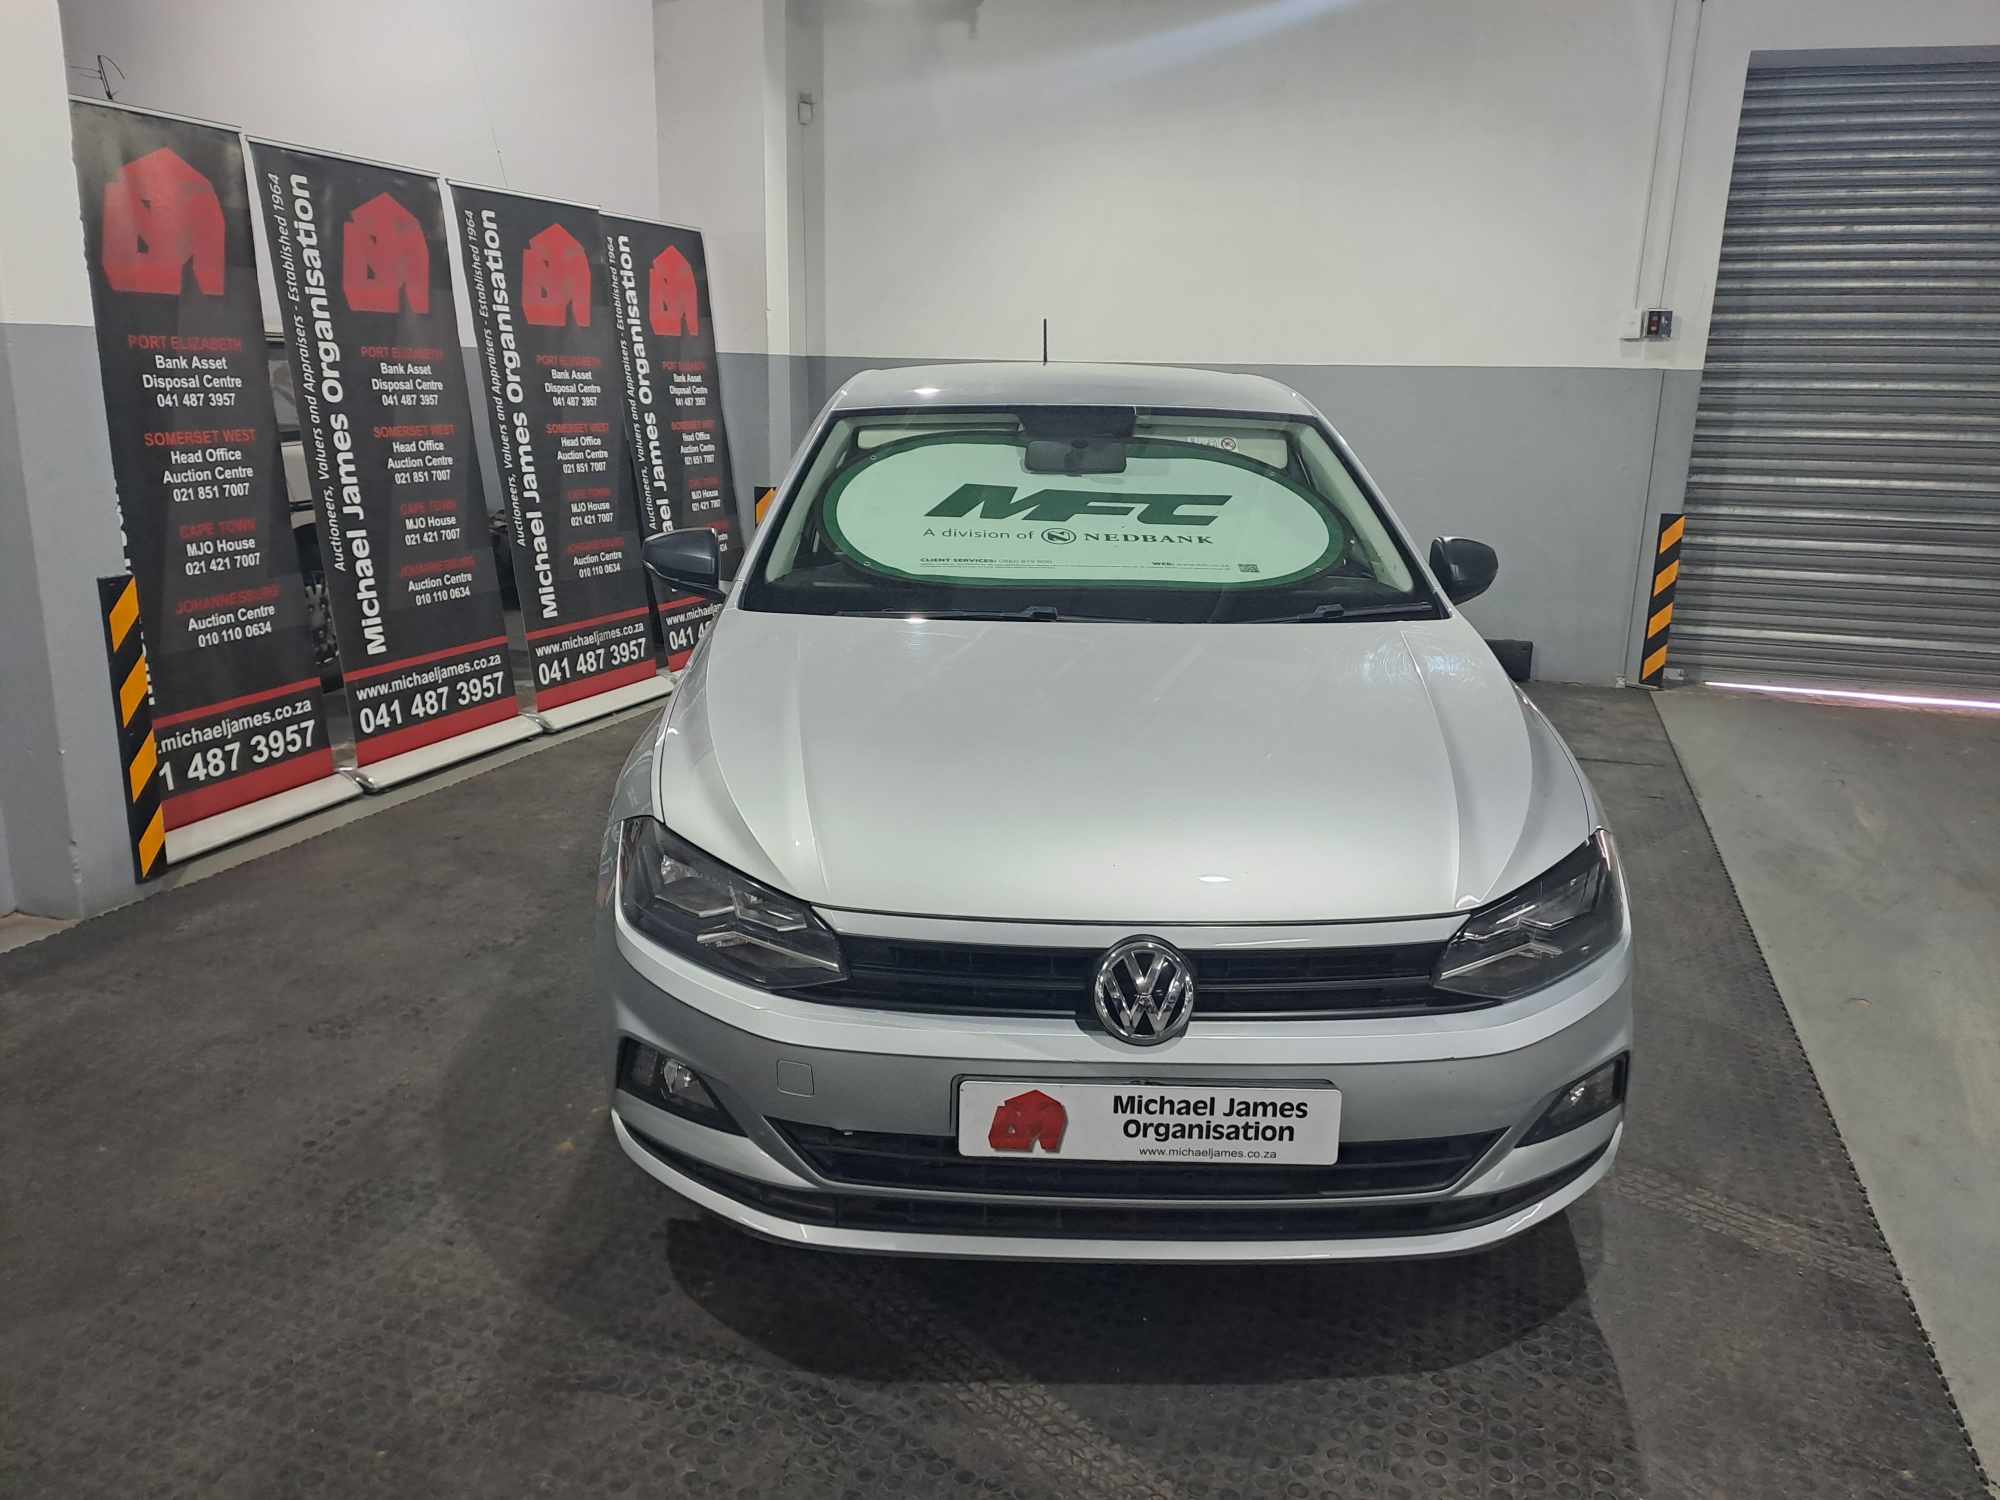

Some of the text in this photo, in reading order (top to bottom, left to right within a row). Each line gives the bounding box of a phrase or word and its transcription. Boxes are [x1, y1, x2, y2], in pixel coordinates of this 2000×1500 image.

[268, 173, 285, 212] 1964
[464, 209, 479, 241] 1964
[278, 215, 300, 302] Established
[617, 235, 653, 405] Organisation
[128, 335, 166, 349] PORT
[295, 315, 316, 392] Appraisers
[155, 355, 227, 369] Bank Asset
[380, 362, 432, 375] Bank Asset
[485, 327, 502, 395] Appraisers
[142, 374, 242, 390] Disposal Centre
[371, 378, 443, 392] Disposal Centre
[551, 369, 592, 380] Bank Asset
[156, 393, 235, 407] 041 487 3957
[382, 394, 438, 406] 041 487 3957
[544, 382, 601, 395] Disposal Centre
[290, 174, 388, 656] Michael James Organisation
[303, 395, 320, 424] and
[481, 209, 558, 619] Michael James Organisation
[492, 396, 505, 421] and
[144, 429, 256, 446] SOMERSET WEST
[393, 440, 444, 453] Head Office
[499, 423, 513, 469] Valuers
[561, 436, 601, 447] Head Office
[171, 448, 242, 464] Head Office
[313, 428, 330, 480] Valuers
[387, 455, 453, 469] Auction Centre
[557, 449, 608, 461] Auction Centre
[644, 411, 667, 492] James
[163, 466, 254, 484] Auction Centre
[394, 469, 451, 484] 021 851 7007
[173, 483, 250, 502] 021 851 7007
[923, 483, 1233, 526] MFC
[323, 486, 346, 572] Auctioneers,
[405, 515, 457, 530] MJO House
[186, 538, 256, 557] MJO House
[405, 528, 460, 546] 021 421 7007
[923, 527, 936, 537] A
[942, 527, 1010, 540] division
[1016, 530, 1035, 540] of
[1083, 532, 1214, 545] NEDBANK
[185, 552, 261, 576] 021 421 7007
[408, 572, 472, 592] Auction Centre
[415, 586, 471, 606] 010 110 0634
[188, 604, 276, 632] Auction Centre
[198, 621, 272, 648] 010 110 0634
[535, 622, 644, 657] www.michaeljames.co.za
[669, 626, 694, 650] 041
[538, 637, 647, 686] 041 487 3957
[356, 654, 501, 701] www.michaeljames.co.za
[359, 671, 504, 734] 041 487 3957
[157, 699, 312, 754] .michaeljames.co.za
[187, 741, 241, 781] 487
[250, 719, 316, 763] 3957
[1113, 1095, 1308, 1119] Michael James
[1122, 1118, 1295, 1143] Organisation
[1139, 1146, 1277, 1160] www.michaeljames.co.za
